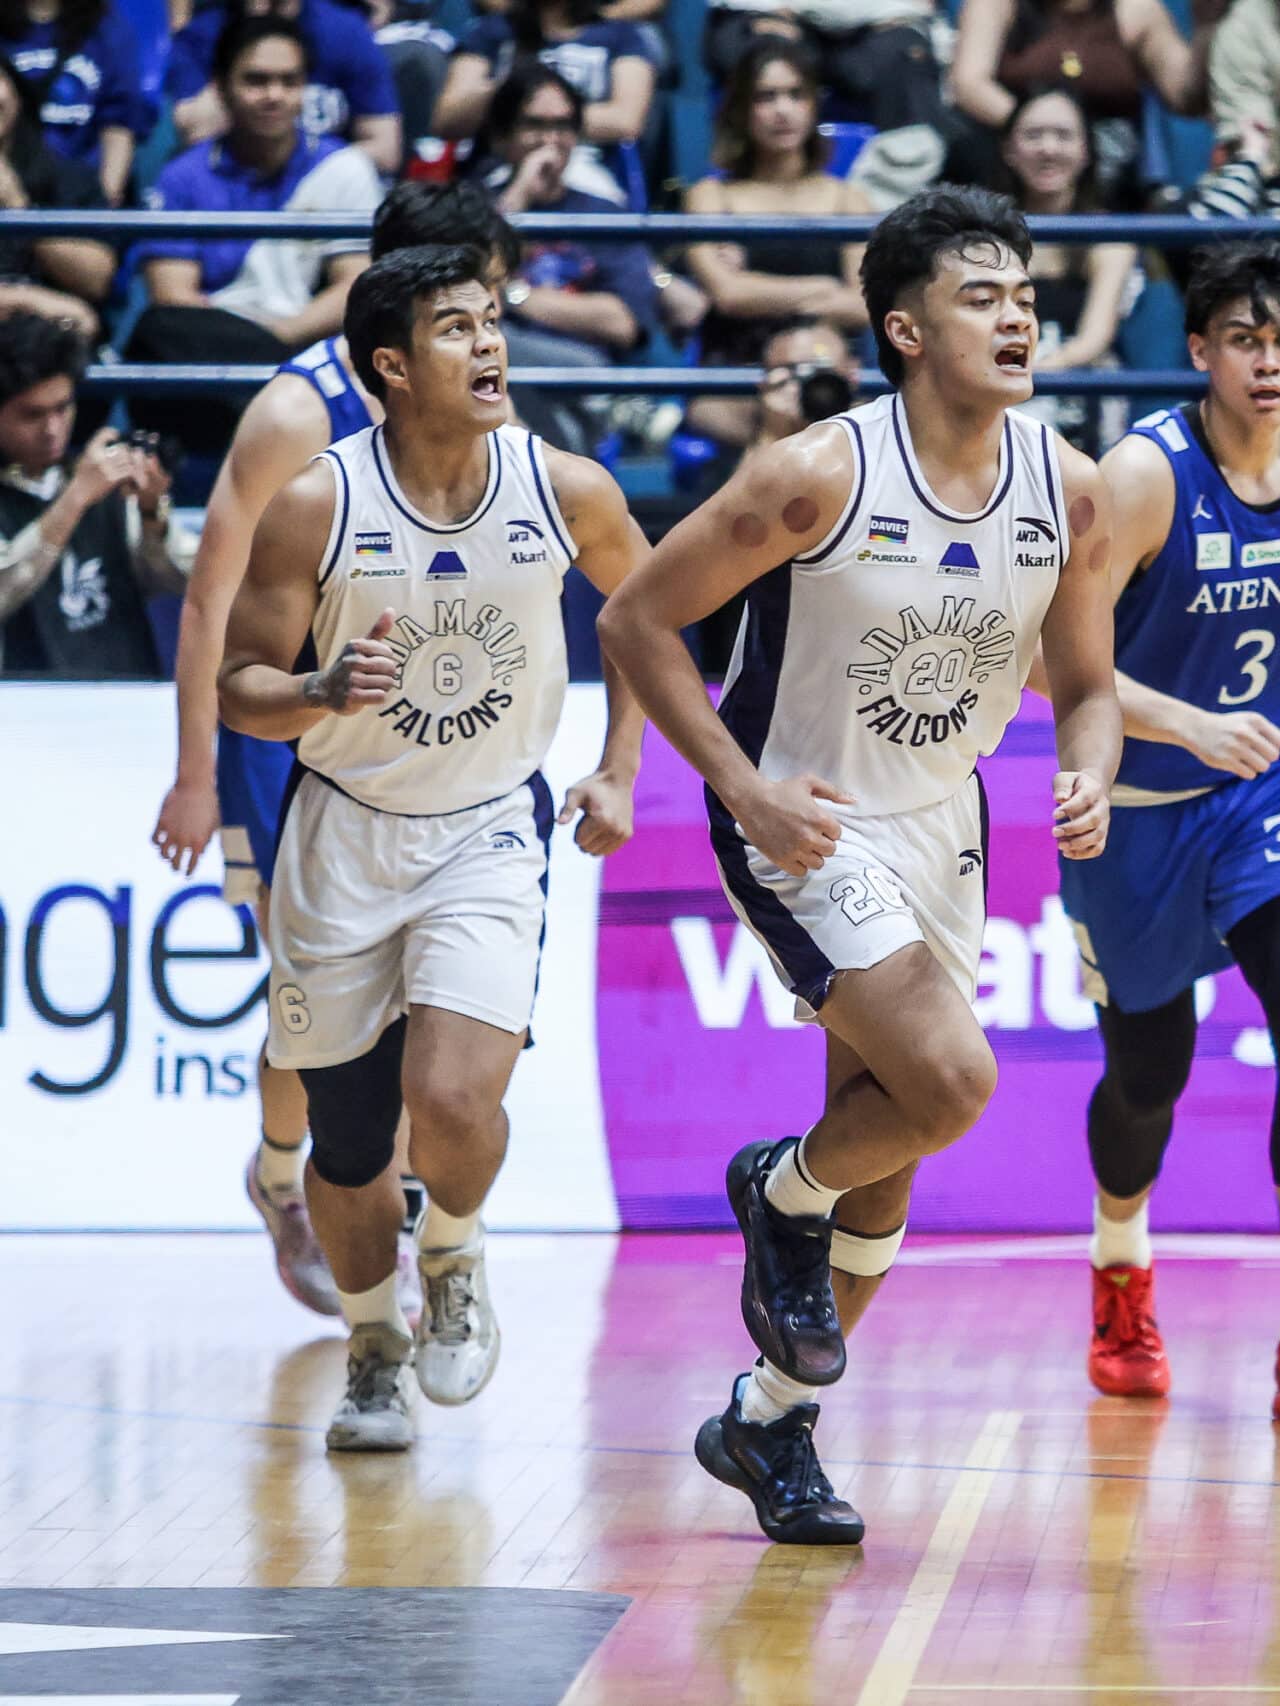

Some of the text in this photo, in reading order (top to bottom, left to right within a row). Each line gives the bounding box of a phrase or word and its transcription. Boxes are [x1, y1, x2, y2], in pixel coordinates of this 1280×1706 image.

[870, 520, 908, 535] DAVIES
[1015, 529, 1040, 543] ANTA
[510, 549, 547, 564] Akari
[871, 552, 918, 564] PUREGOLD
[1014, 553, 1056, 567] Akari
[846, 595, 1015, 685] ADAMSON
[433, 653, 464, 696] 6
[903, 648, 967, 695] 20
[1217, 629, 1276, 705] 3
[378, 688, 513, 747] FALCONS
[856, 688, 978, 747] FALCONS
[276, 982, 312, 1034] 6
